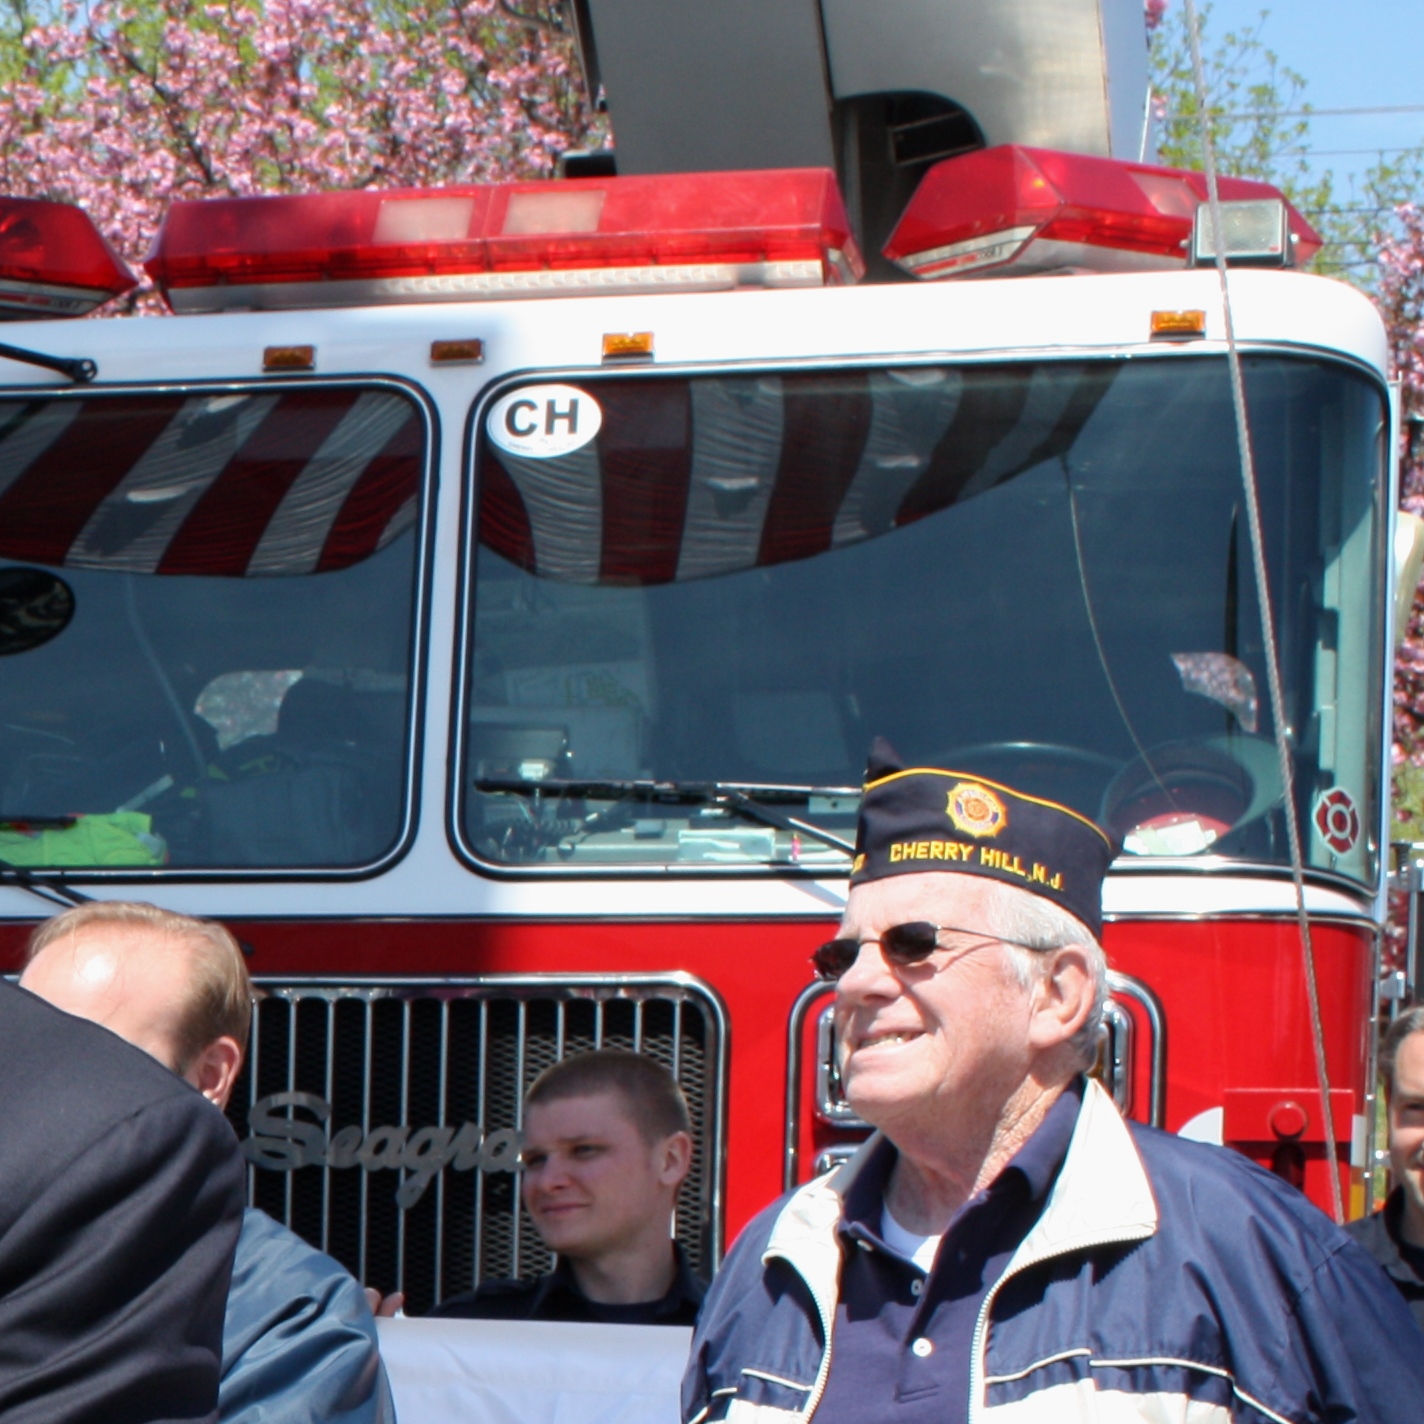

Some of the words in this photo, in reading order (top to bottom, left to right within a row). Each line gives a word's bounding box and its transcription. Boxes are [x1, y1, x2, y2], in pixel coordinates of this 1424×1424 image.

[505, 398, 579, 438] CH
[889, 840, 974, 863] CHERRY
[240, 1090, 524, 1209] Seagra
